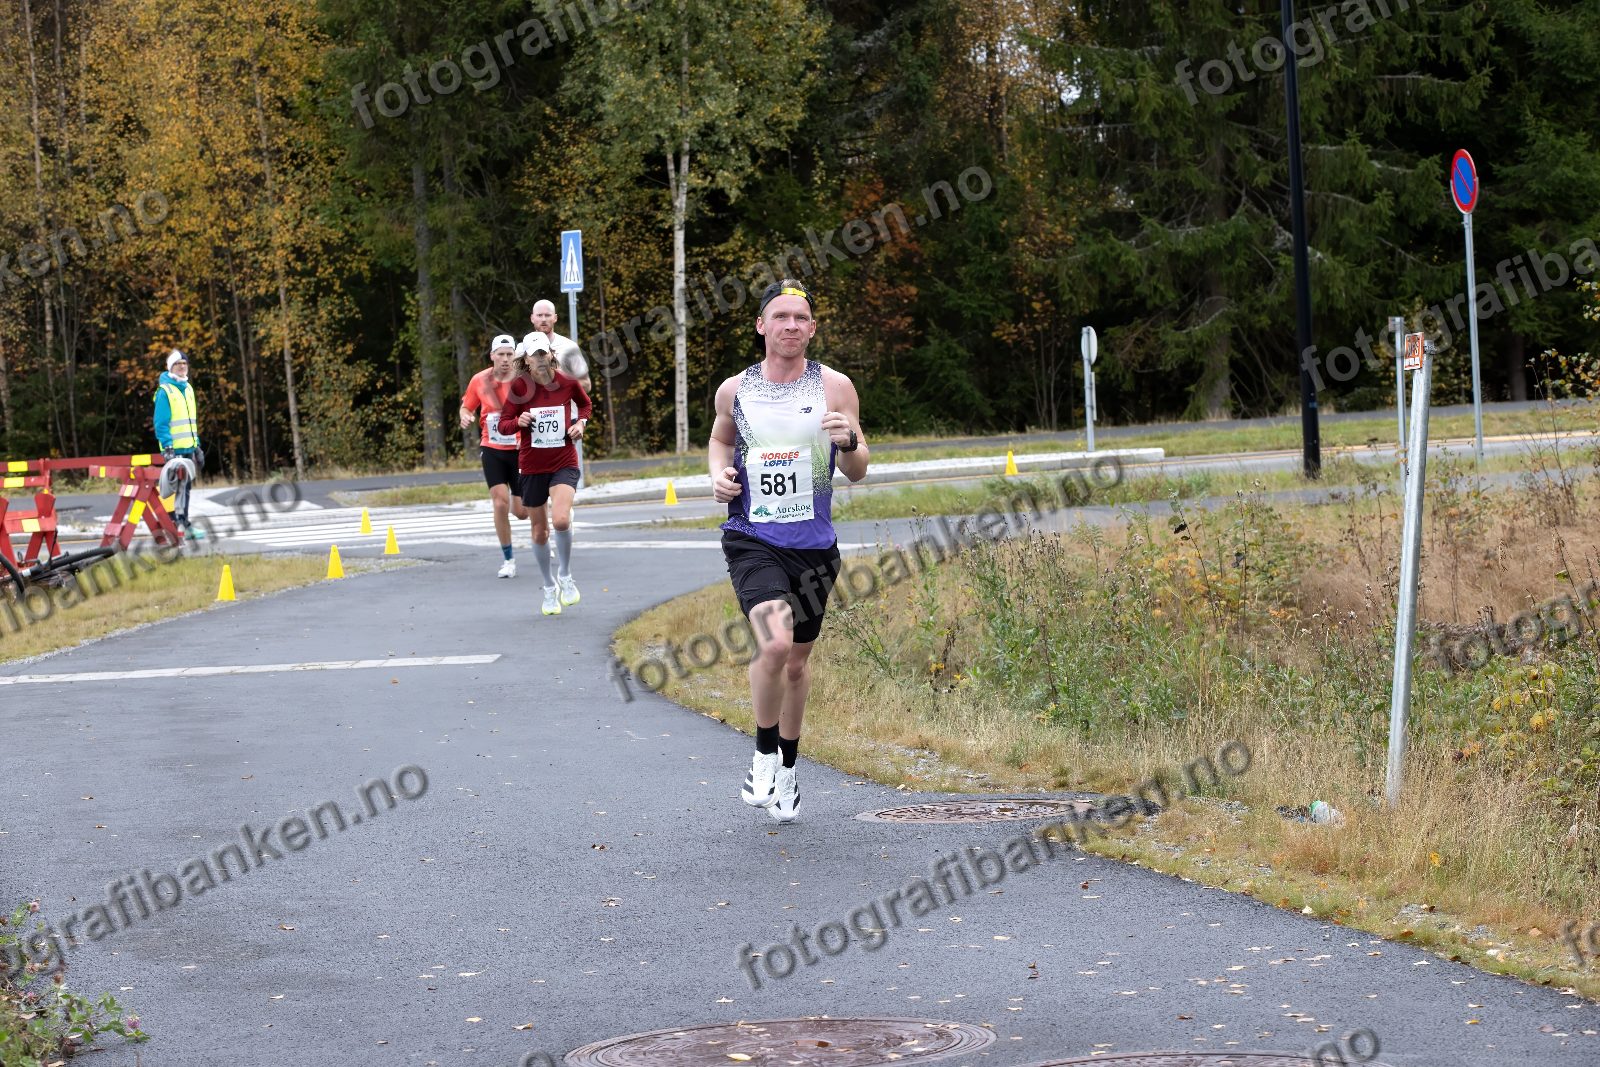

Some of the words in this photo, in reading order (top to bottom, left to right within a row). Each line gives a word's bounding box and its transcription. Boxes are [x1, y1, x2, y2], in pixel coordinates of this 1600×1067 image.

[538, 420, 559, 433] 679
[760, 451, 800, 460] NORGES
[760, 471, 797, 497] 581
